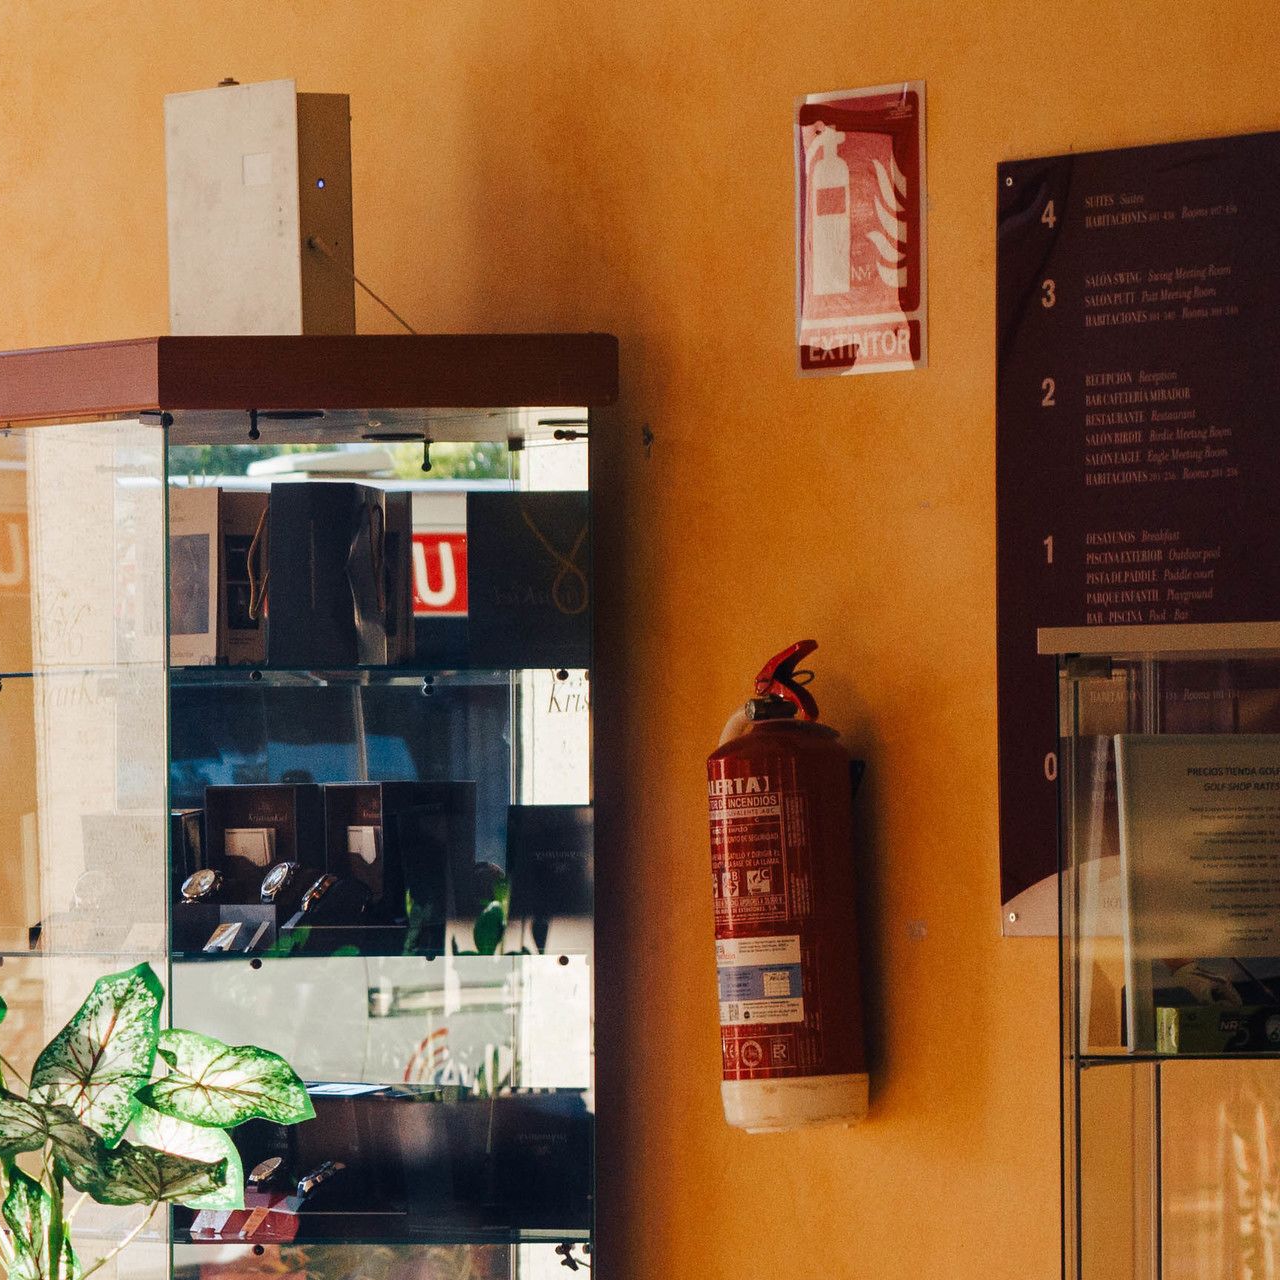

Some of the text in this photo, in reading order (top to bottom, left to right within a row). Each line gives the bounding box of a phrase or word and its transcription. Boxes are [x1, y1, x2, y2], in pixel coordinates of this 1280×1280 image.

[1041, 200, 1056, 228] 4
[1086, 212, 1147, 228] HABITACIONES
[1041, 279, 1056, 308] 3
[1086, 311, 1148, 327] HABITACIONES
[810, 329, 910, 361] EXTINTOR
[1042, 378, 1056, 407] 2
[1086, 394, 1101, 407] BAR
[1150, 387, 1191, 401] MIRADOR
[1086, 411, 1144, 426] RESTAURANTE
[1086, 471, 1148, 486] HABITACIONES
[1086, 531, 1136, 545] DESAYUNOS
[1044, 536, 1054, 564] 1
[1086, 551, 1120, 564] PISCINA
[1120, 549, 1163, 563] EXTERIOR
[412, 541, 457, 606] U
[1086, 572, 1110, 585] PISTA
[1086, 592, 1120, 606] PARQUE
[1086, 612, 1103, 625] BAR
[1109, 610, 1143, 622] PISCINA
[1187, 767, 1224, 776] PRECIOS
[1224, 767, 1257, 776] TIENDA
[1204, 782, 1280, 791] GOLF SHOP RATES
[728, 796, 777, 808] INCENDIOS
[732, 870, 738, 881] B
[760, 870, 770, 878] C
